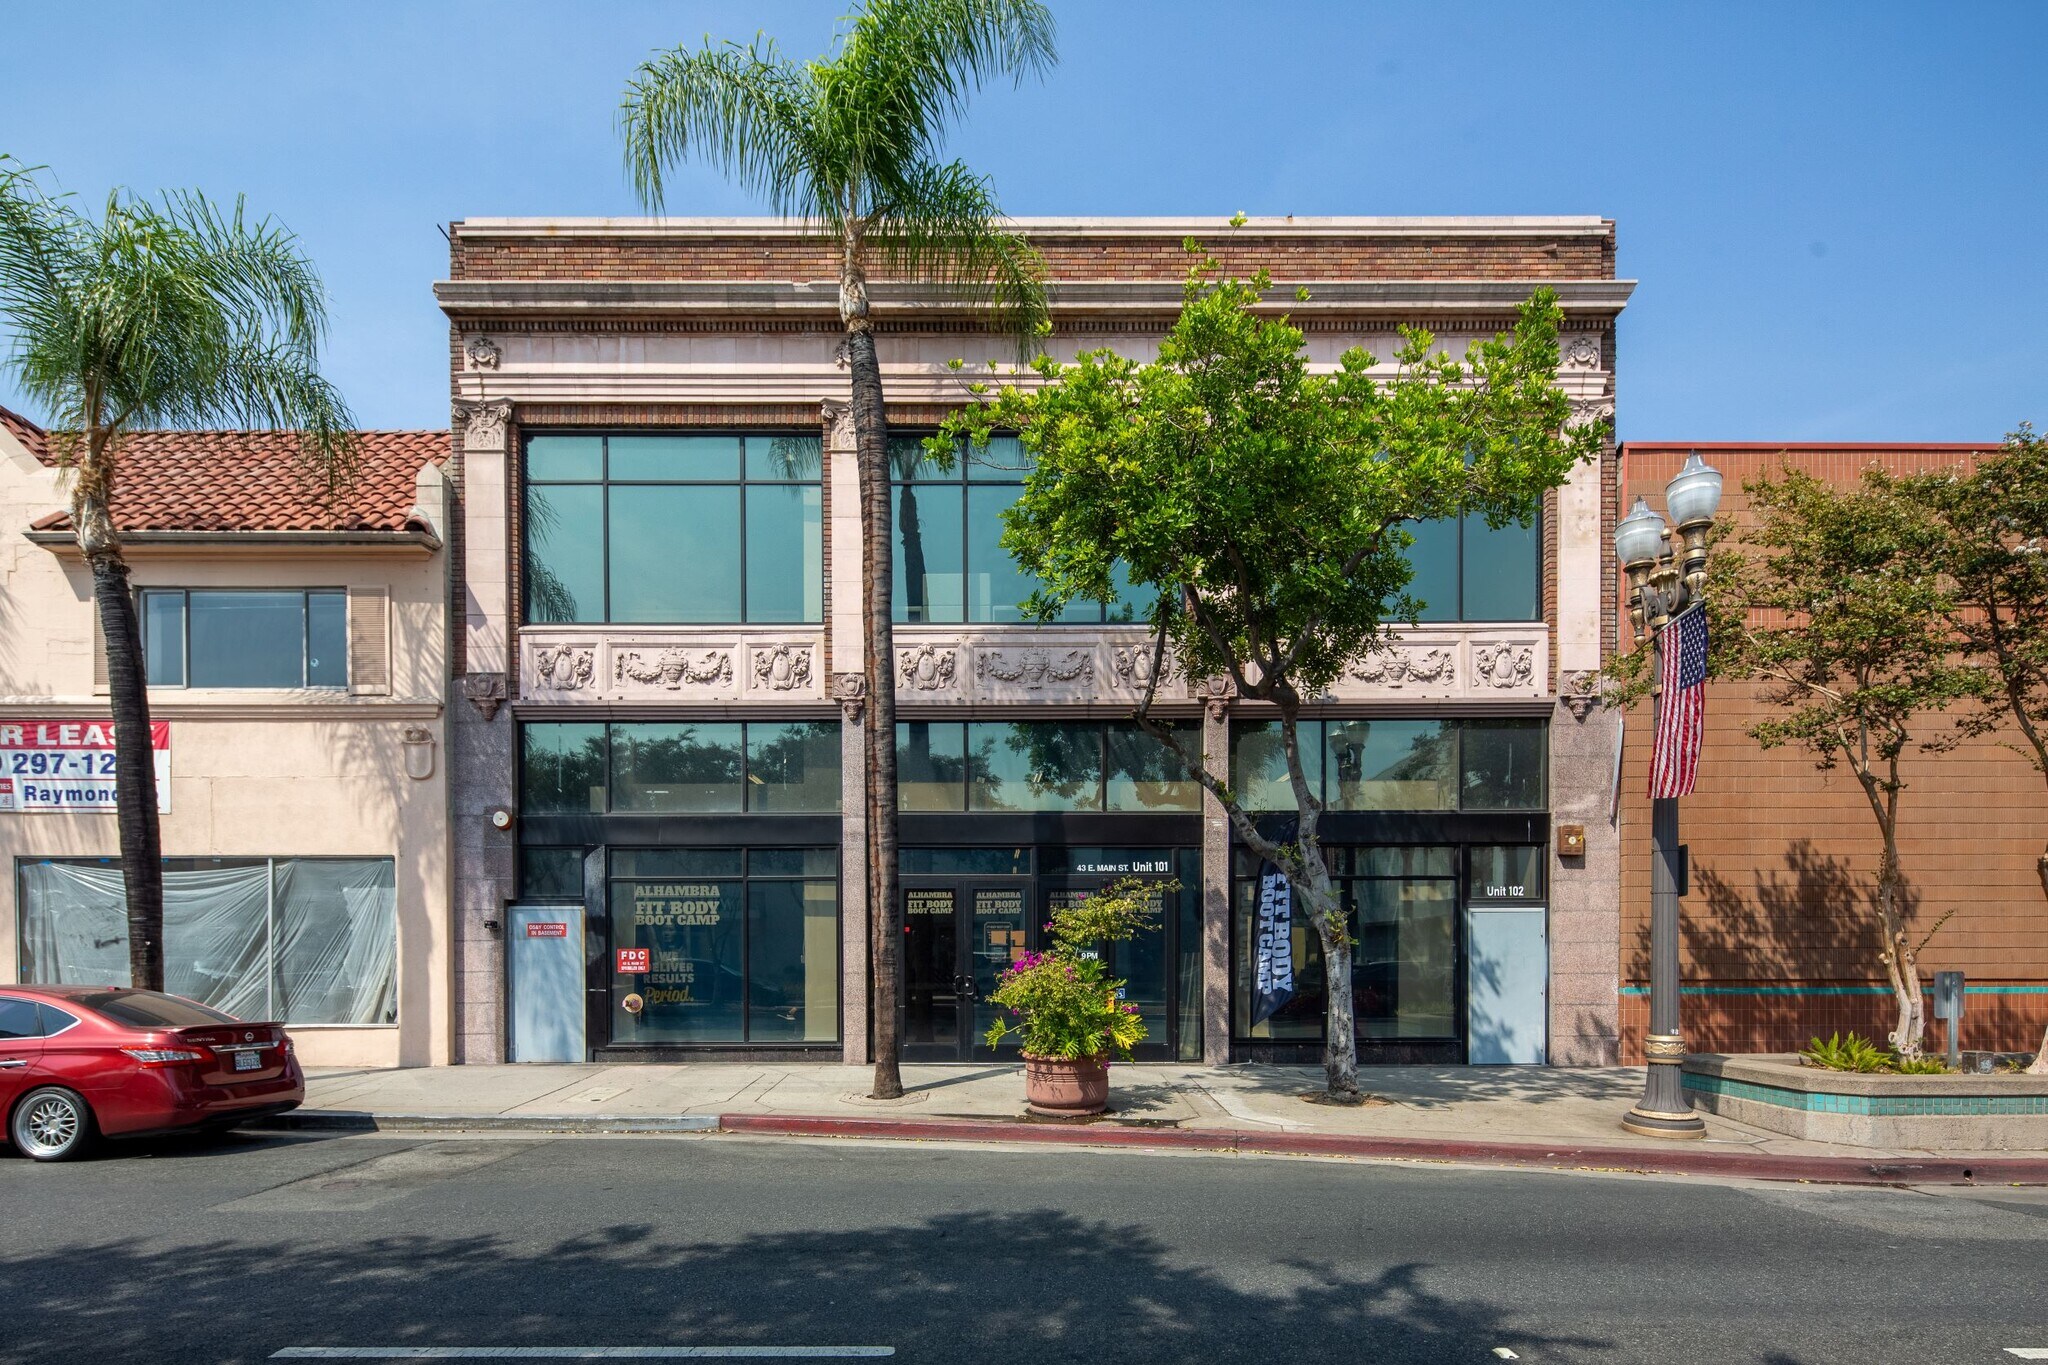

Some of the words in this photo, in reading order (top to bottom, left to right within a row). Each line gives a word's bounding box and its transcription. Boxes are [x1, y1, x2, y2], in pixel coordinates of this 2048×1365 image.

[37, 724, 116, 746] LEA
[1077, 864, 1086, 872] 43
[1133, 862, 1152, 872] Unit
[1155, 862, 1168, 872] 101
[636, 885, 720, 896] ALHAMBRA
[1487, 886, 1506, 896] Unit
[1509, 886, 1524, 896] 102
[636, 901, 665, 914] FIT
[670, 901, 720, 914] BODY
[908, 900, 923, 908] FIT
[926, 900, 953, 908] BODY
[976, 900, 992, 908] FIT
[995, 900, 1021, 908] BODY
[1260, 874, 1276, 932] BOOT
[635, 915, 674, 925] BOOT
[677, 915, 720, 925] CAMP
[660, 952, 678, 961] WE
[1273, 921, 1292, 992] BODY
[649, 962, 694, 972] ELIVER
[1257, 933, 1273, 995] CAMP
[643, 974, 694, 983] RESULTS
